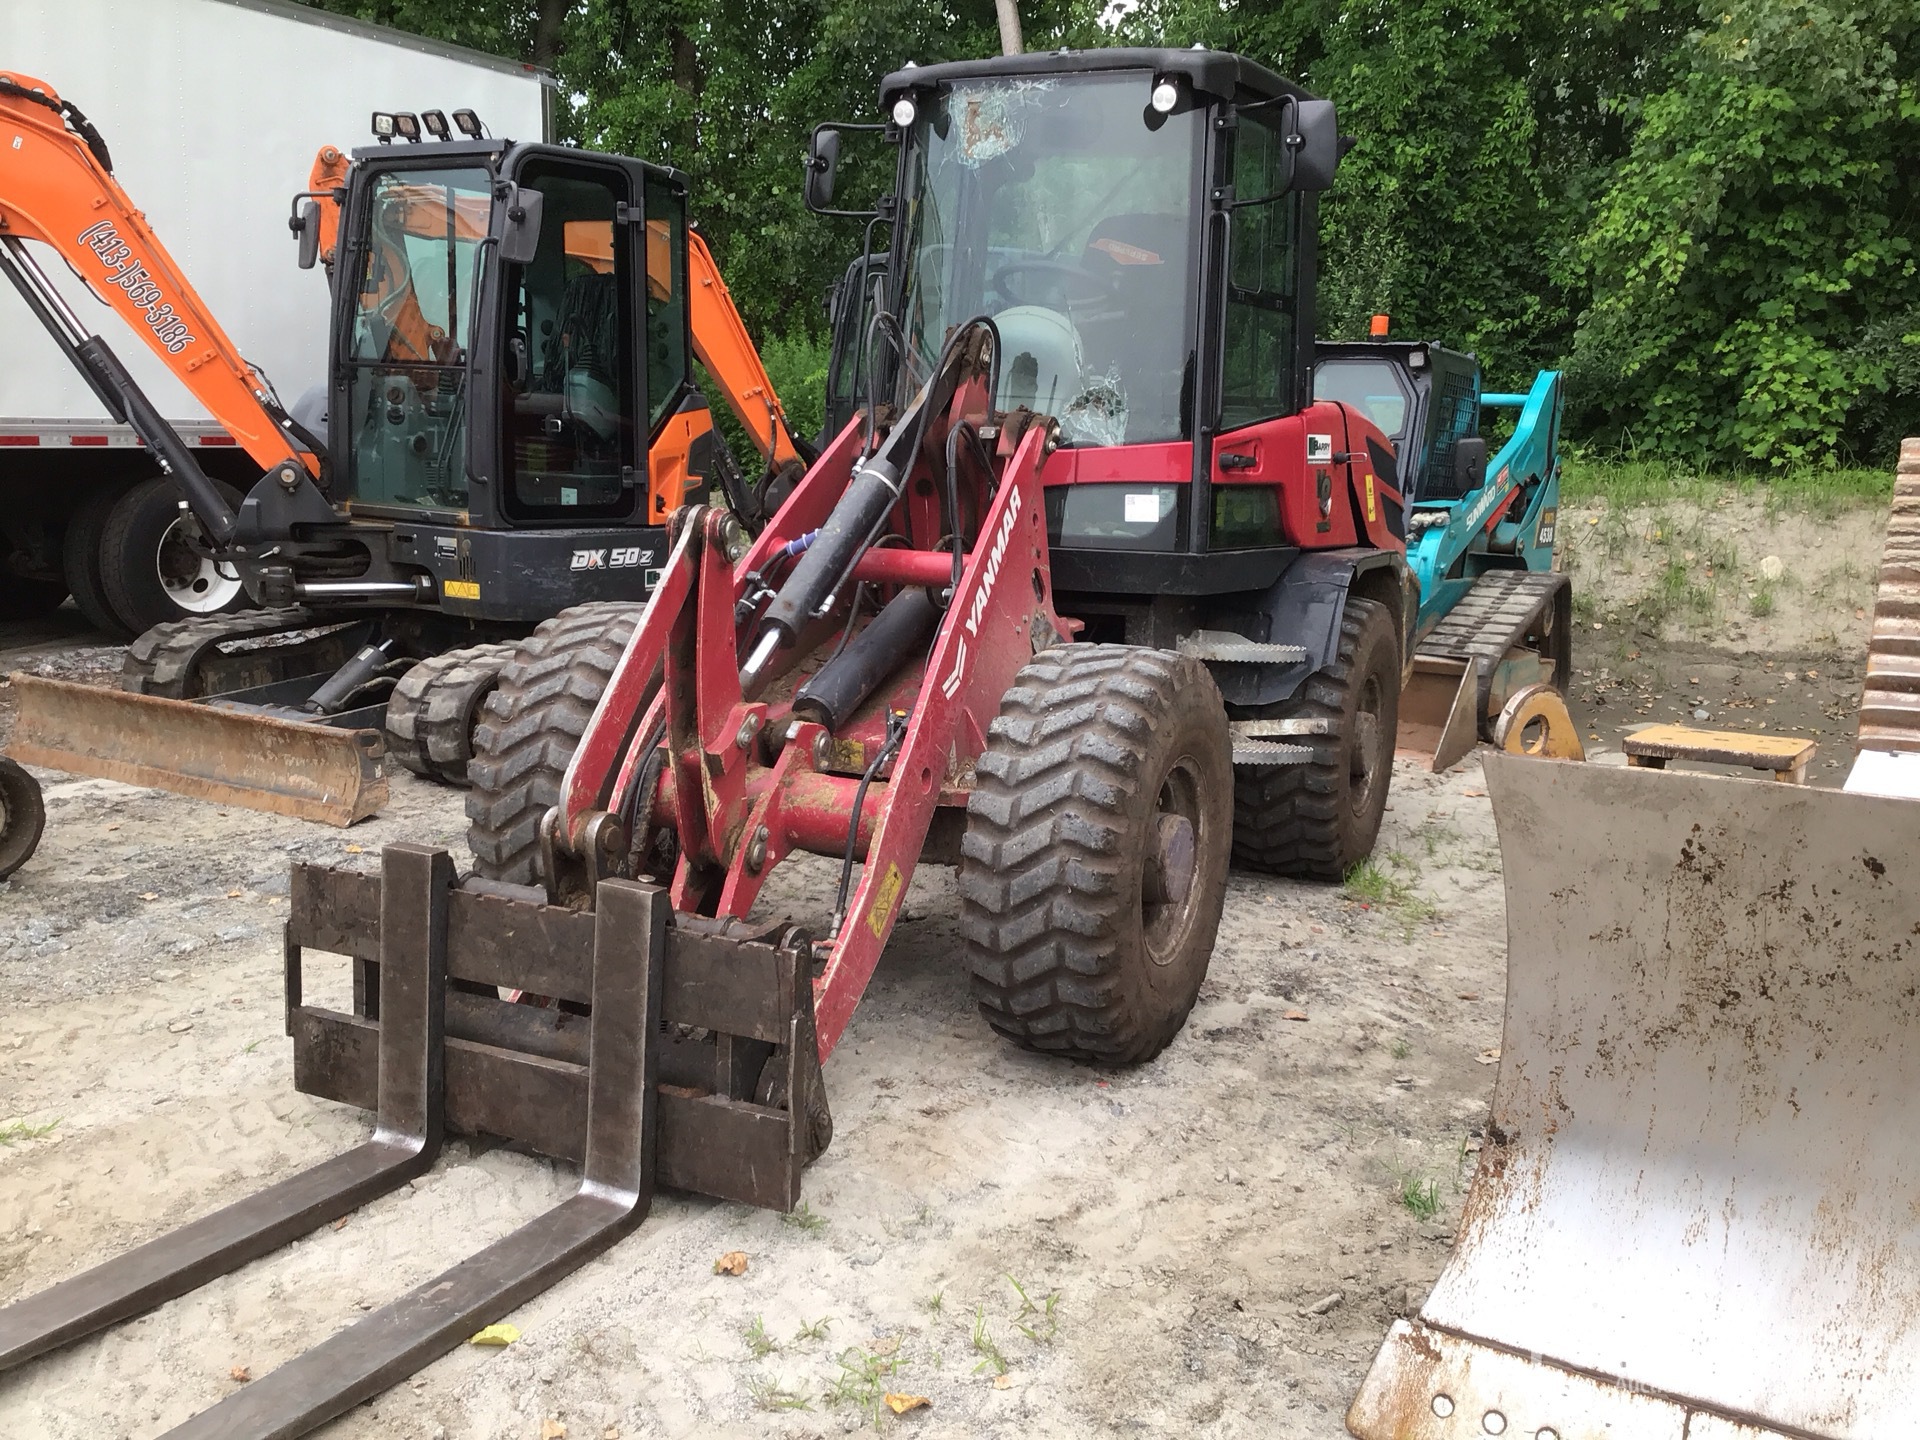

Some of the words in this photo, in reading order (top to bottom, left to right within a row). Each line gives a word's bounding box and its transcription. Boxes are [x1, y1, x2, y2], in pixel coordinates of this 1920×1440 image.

[77, 219, 196, 354] (413-)569-3186
[570, 549, 607, 571] DX
[965, 484, 1022, 638] YANMAR
